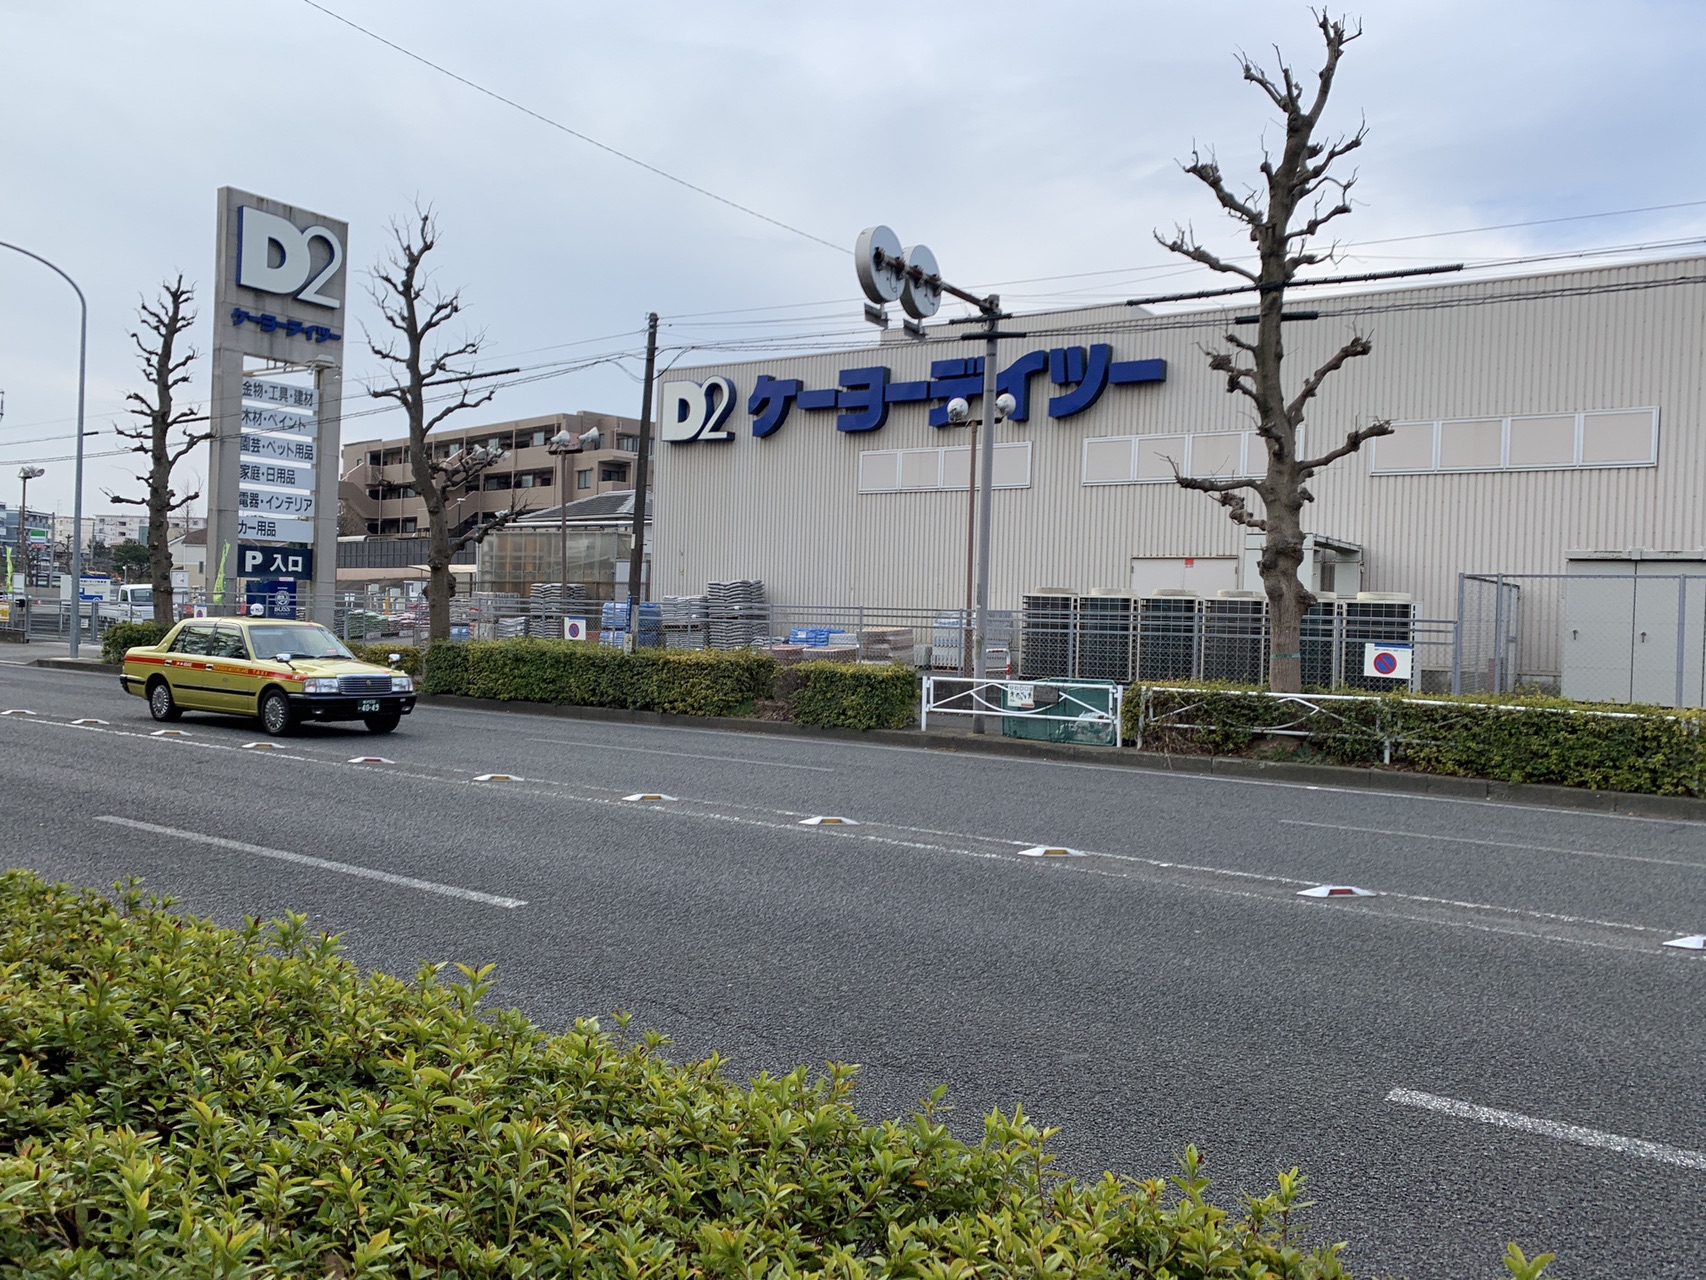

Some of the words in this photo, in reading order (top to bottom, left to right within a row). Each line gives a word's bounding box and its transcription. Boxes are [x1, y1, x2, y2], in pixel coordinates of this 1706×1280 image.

[236, 205, 343, 309] D2
[242, 380, 313, 406] 金物・工具・建材
[241, 408, 307, 432] 木材・ペイント
[662, 375, 735, 442] D2
[240, 435, 314, 461] 園芸・ペット用品
[240, 464, 295, 485] 家庭・日用品
[239, 491, 312, 512] 電器・インテリア
[238, 520, 277, 537] カー用品
[245, 551, 262, 572] P
[270, 554, 302, 572] 入口
